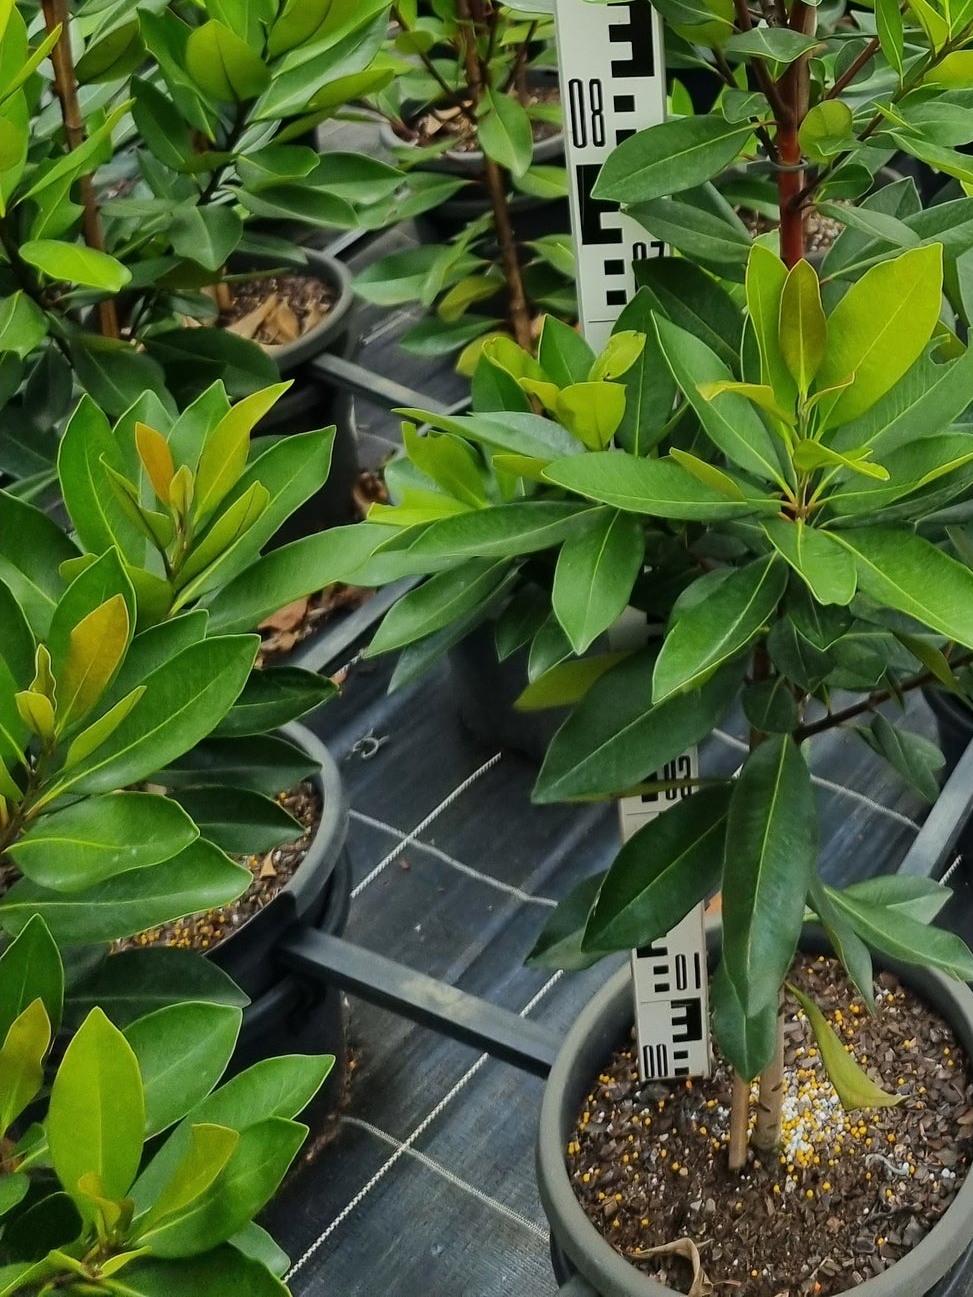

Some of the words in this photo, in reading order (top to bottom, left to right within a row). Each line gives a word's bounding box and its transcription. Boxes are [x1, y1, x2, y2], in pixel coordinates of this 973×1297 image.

[568, 78, 606, 149] 08
[675, 952, 701, 991] 01
[643, 1044, 668, 1079] 00
